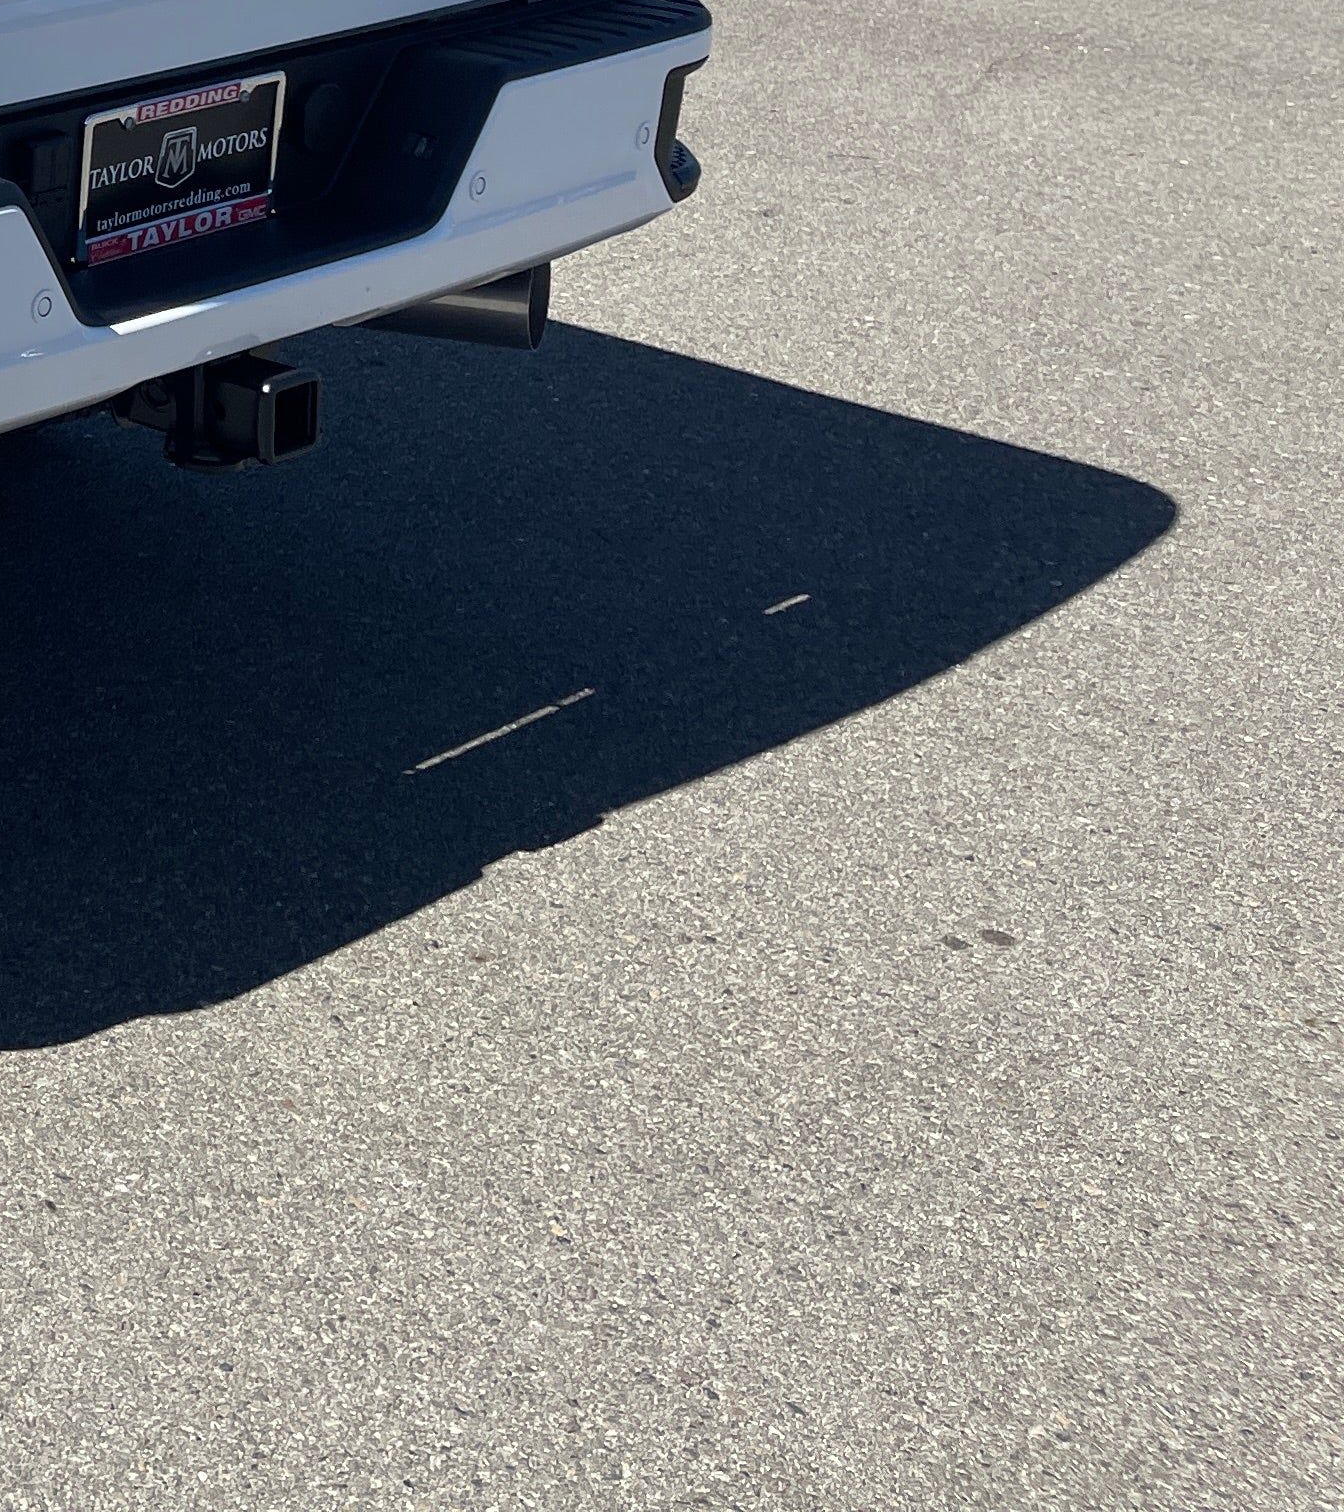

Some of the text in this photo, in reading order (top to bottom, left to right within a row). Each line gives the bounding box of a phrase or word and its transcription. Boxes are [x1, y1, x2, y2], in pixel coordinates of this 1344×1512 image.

[138, 84, 240, 121] REDDING
[90, 127, 268, 190] TAYLOR MOTORS
[97, 183, 250, 231] taylormotorsredding.com
[127, 204, 267, 251] TAYLOR GMC
